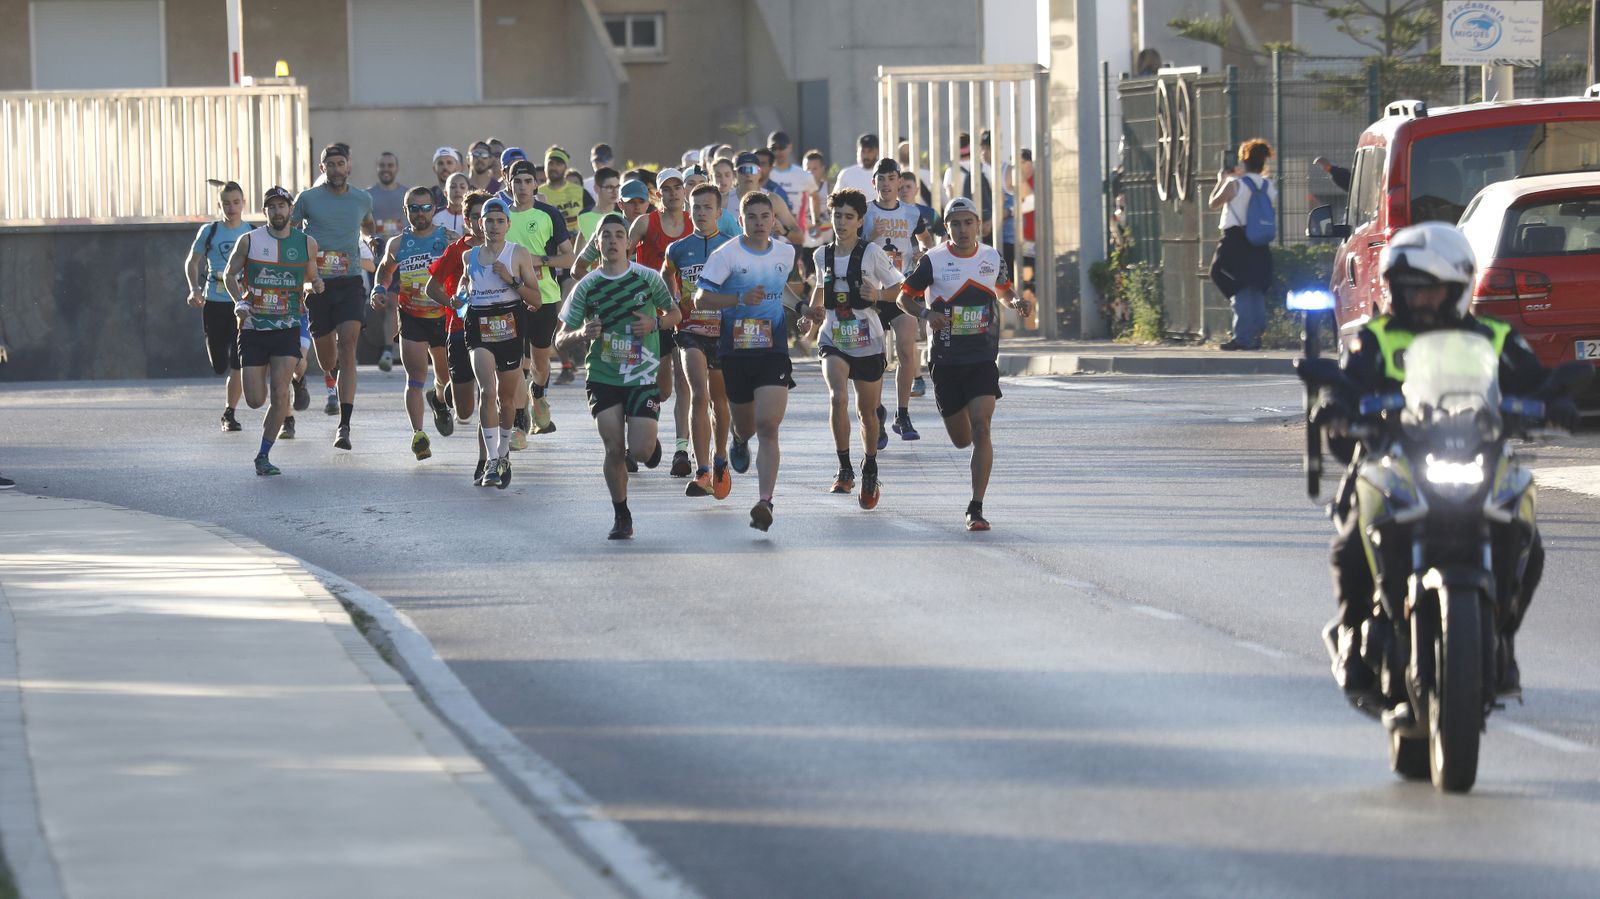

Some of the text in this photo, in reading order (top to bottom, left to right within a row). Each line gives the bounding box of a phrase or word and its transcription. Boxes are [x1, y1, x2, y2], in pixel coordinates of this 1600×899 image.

[325, 255, 340, 264] 373
[1526, 303, 1552, 311] GOLF
[963, 311, 983, 321] 604
[489, 319, 507, 330] 330
[743, 323, 760, 335] 521
[840, 325, 859, 336] 605
[611, 339, 632, 350] 606
